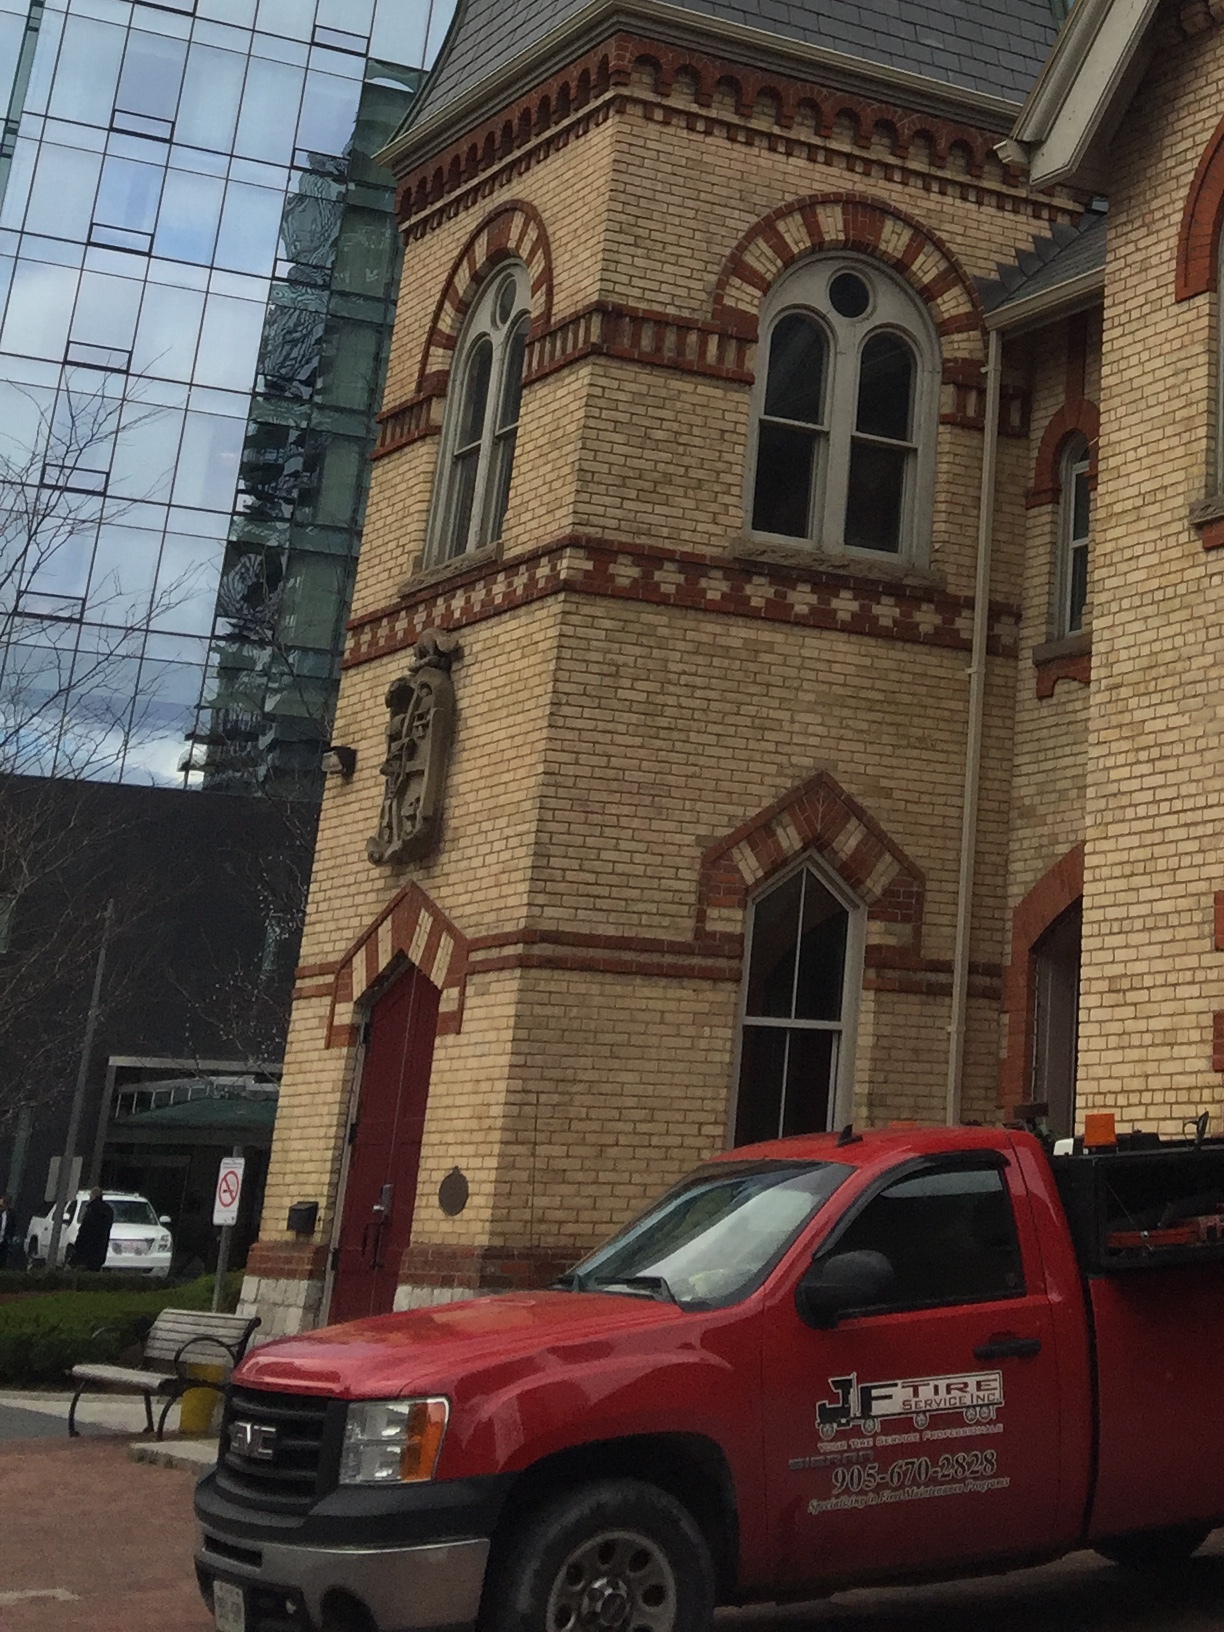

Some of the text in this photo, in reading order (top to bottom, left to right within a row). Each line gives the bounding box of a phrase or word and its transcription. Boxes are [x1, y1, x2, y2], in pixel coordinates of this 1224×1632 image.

[901, 1378, 998, 1399] TIRE
[902, 1391, 1001, 1411] SERVICE INC.
[876, 1432, 920, 1446] SERVICE
[922, 1423, 1004, 1441] PROFESSIONALS
[832, 1449, 997, 1495] 905-670-2828
